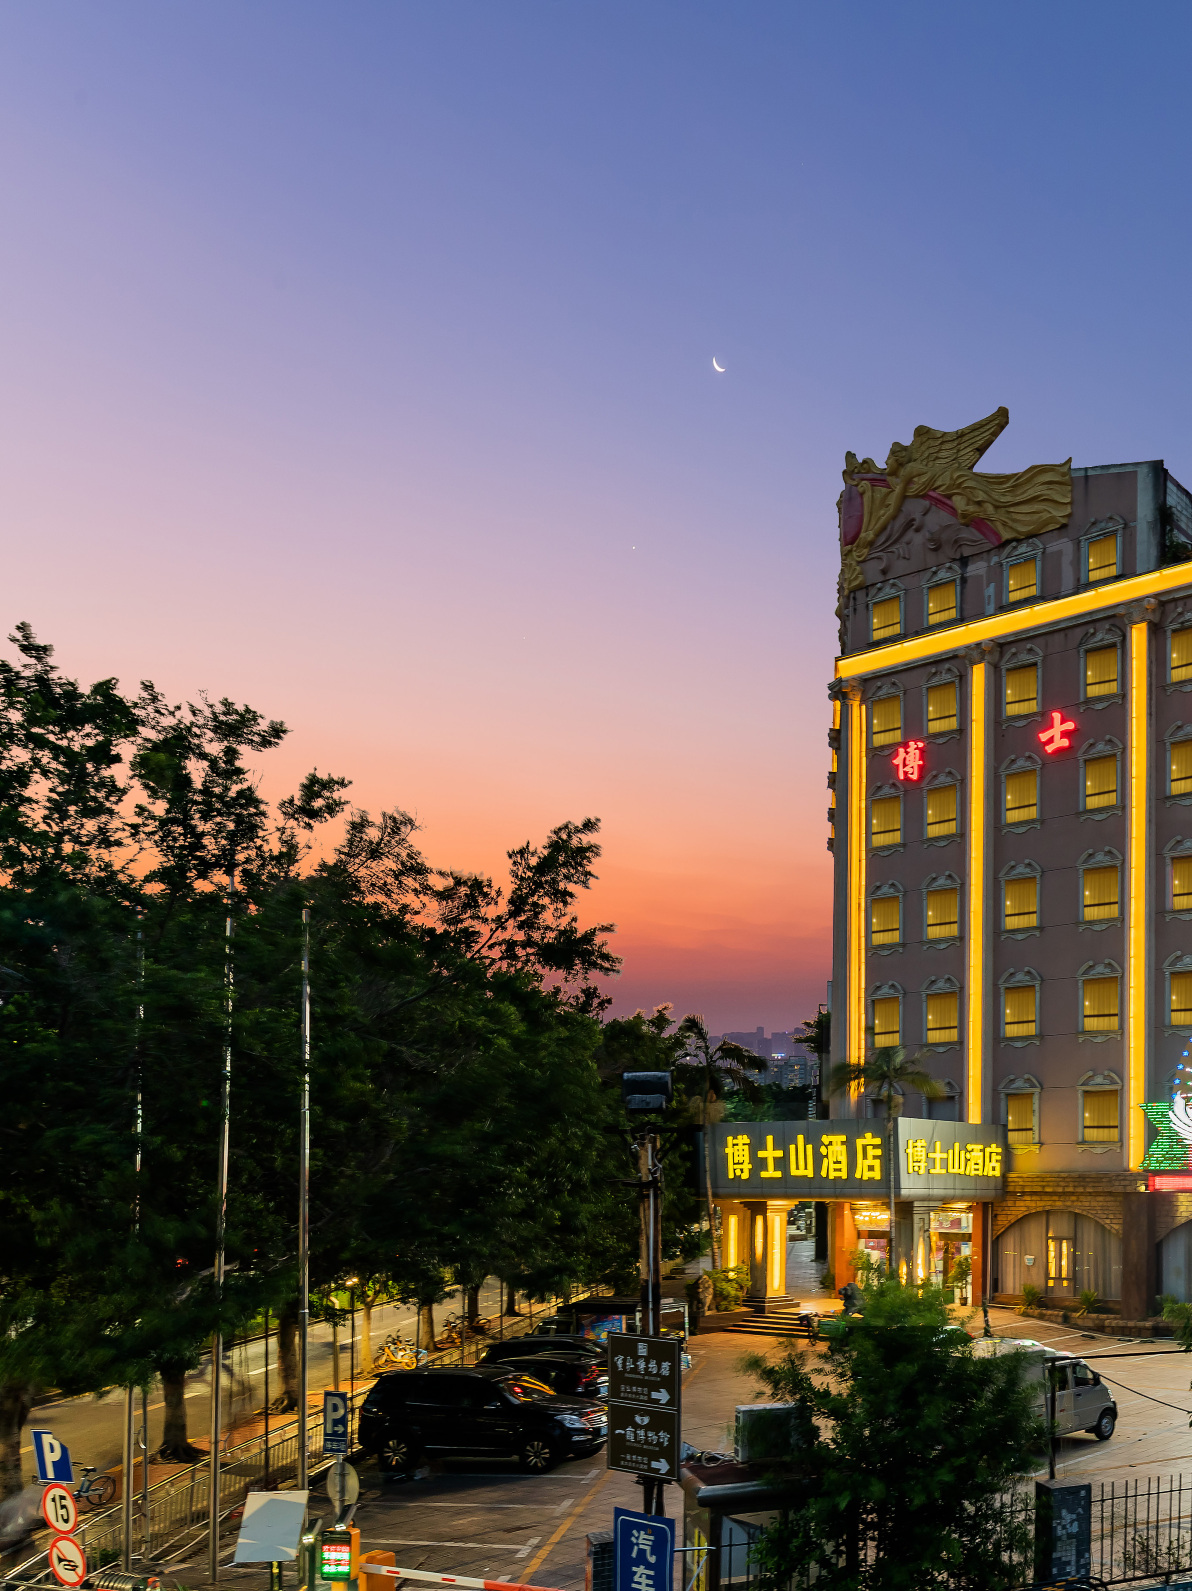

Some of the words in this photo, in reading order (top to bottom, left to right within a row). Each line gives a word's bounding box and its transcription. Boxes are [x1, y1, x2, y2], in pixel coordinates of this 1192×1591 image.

[724, 1132, 882, 1181] 博士山酒店
[905, 1138, 1002, 1178] 博士山酒店
[326, 1396, 345, 1434] P
[41, 1434, 62, 1479] P
[51, 1494, 70, 1524] 15
[630, 1529, 657, 1591] 汽车
